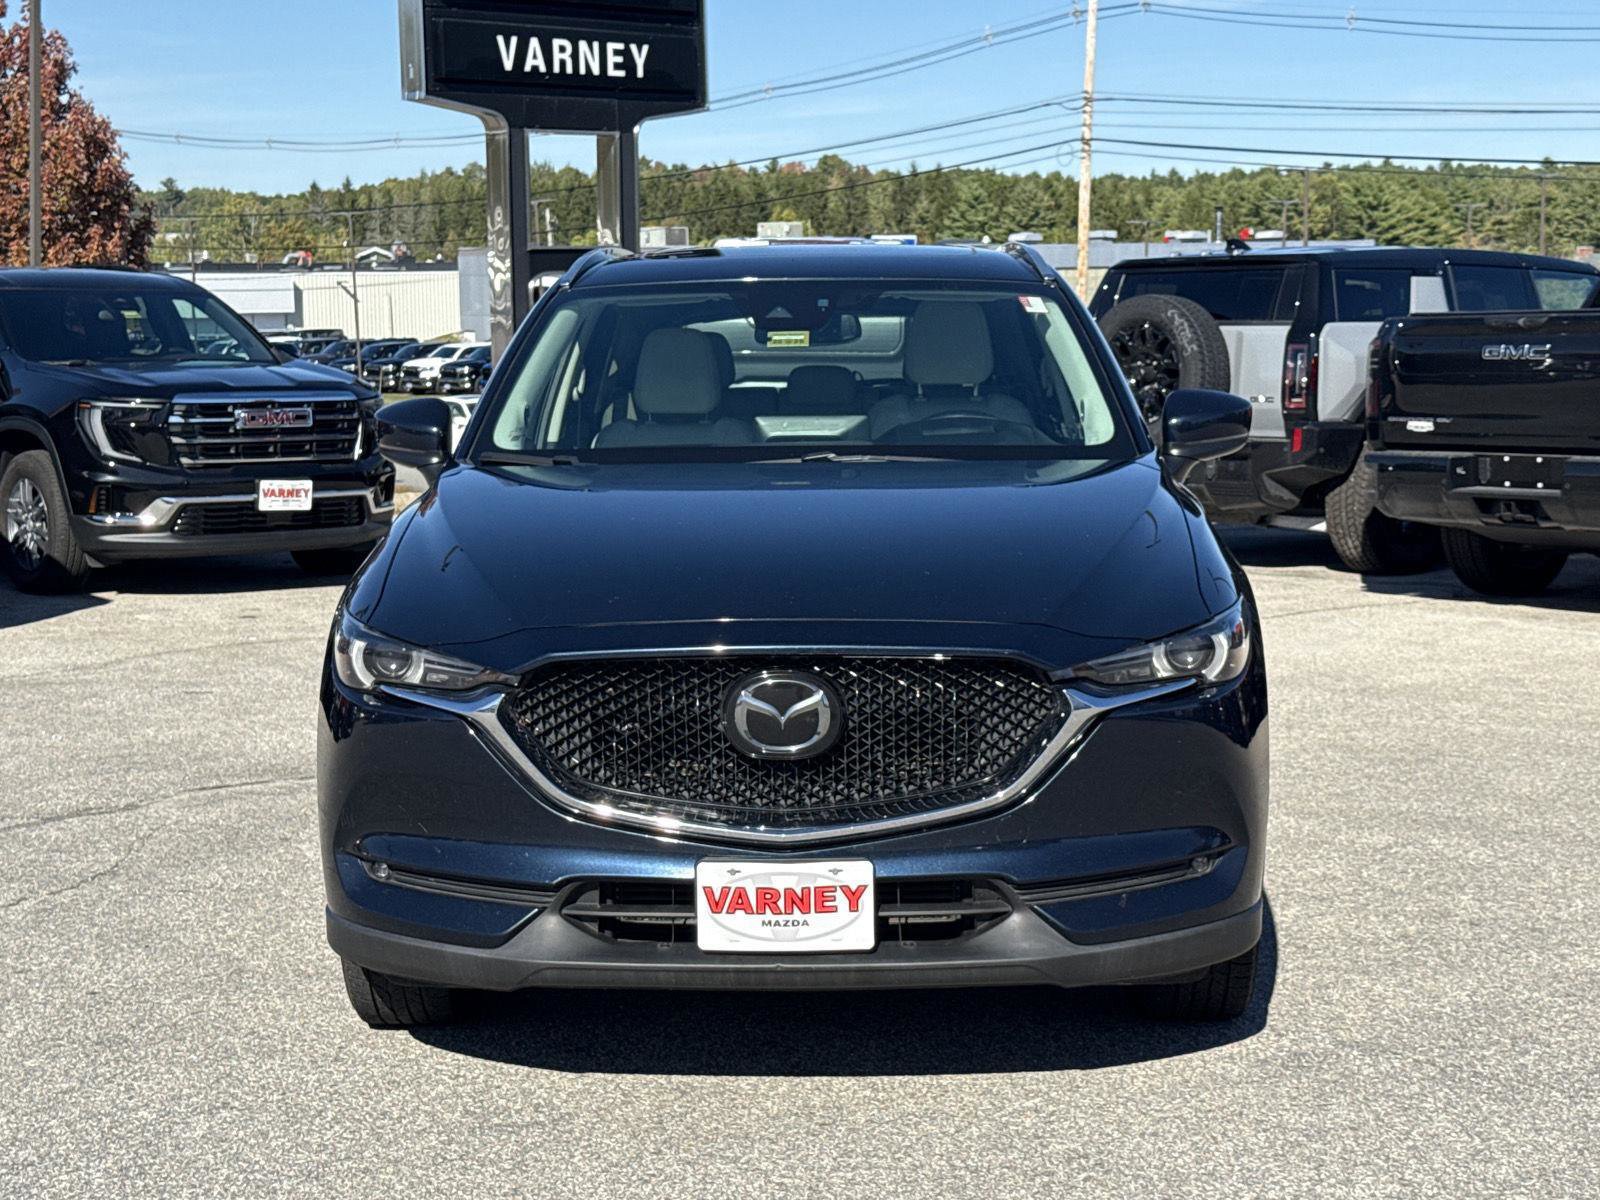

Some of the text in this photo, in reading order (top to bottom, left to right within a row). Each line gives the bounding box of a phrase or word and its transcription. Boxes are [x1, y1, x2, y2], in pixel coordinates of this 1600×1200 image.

[496, 35, 650, 78] VARNEY
[1482, 344, 1551, 360] GMC
[262, 488, 310, 498] VARNEY
[703, 885, 868, 915] VARNEY
[761, 919, 809, 927] MAZDA
